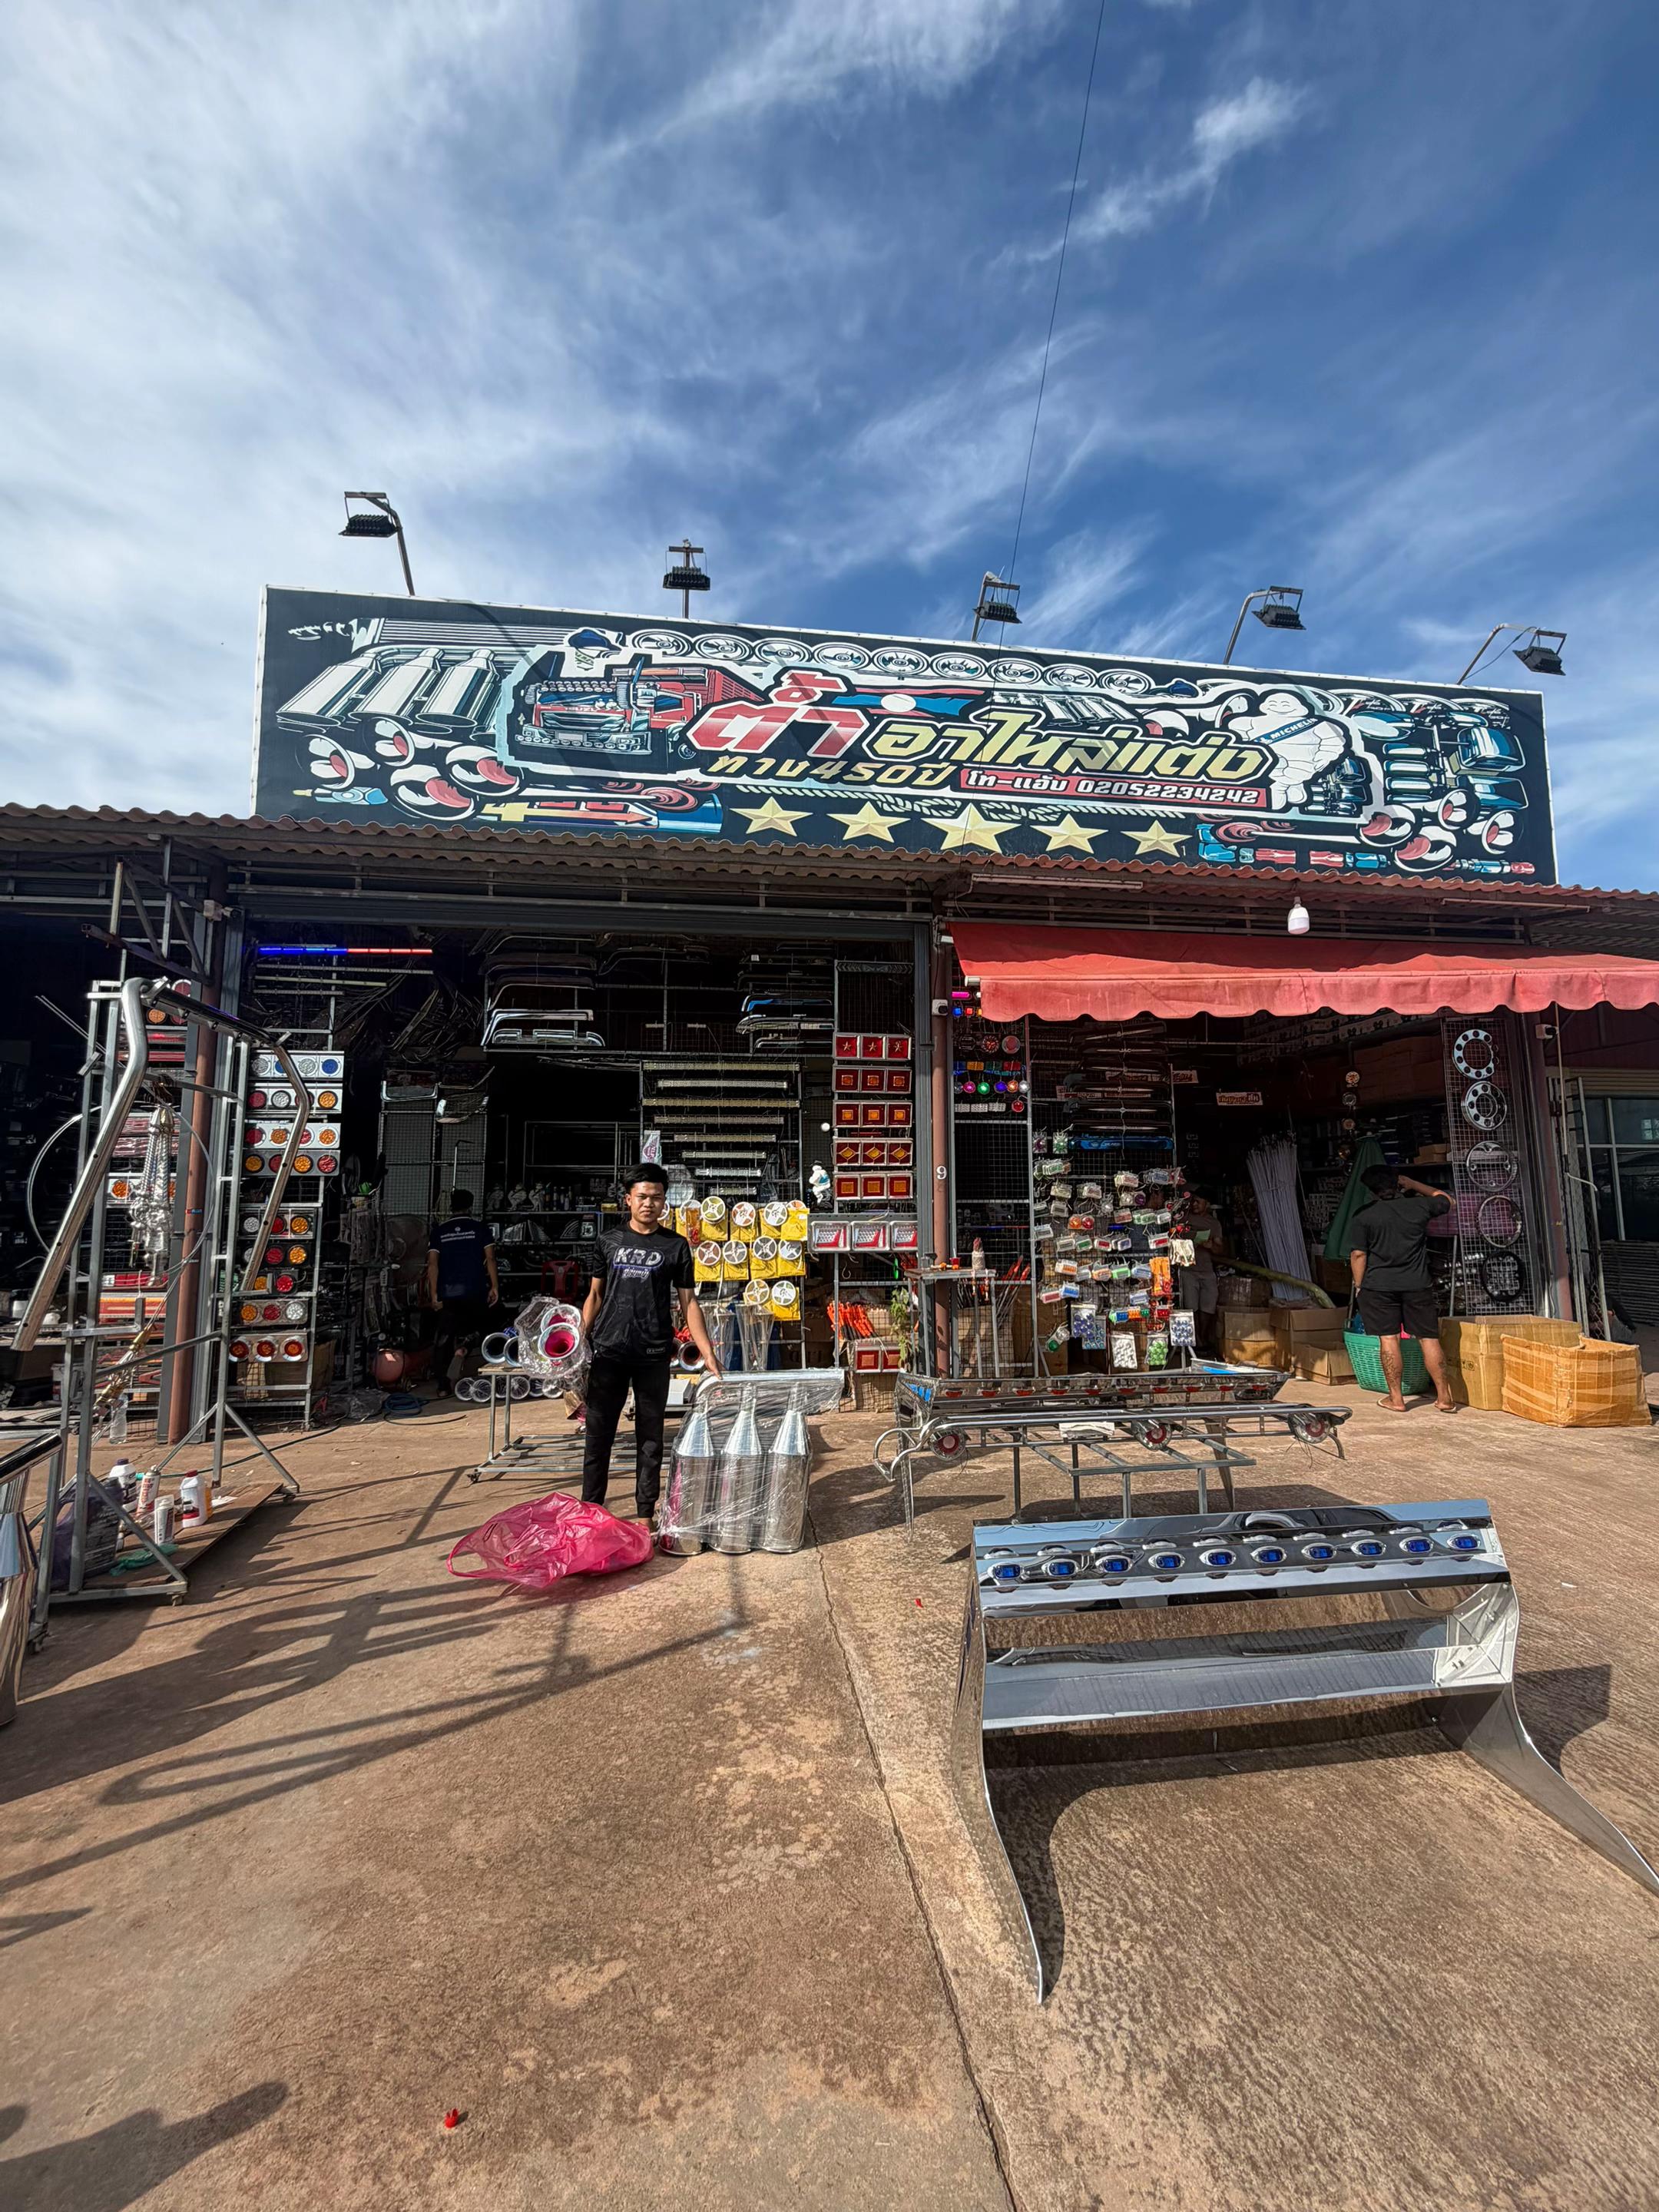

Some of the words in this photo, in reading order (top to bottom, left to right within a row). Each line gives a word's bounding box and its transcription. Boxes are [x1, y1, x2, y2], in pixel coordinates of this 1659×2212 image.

[1077, 779, 1260, 804] 02052234242
[936, 1165, 947, 1180] 9
[615, 1247, 662, 1266] KRD
